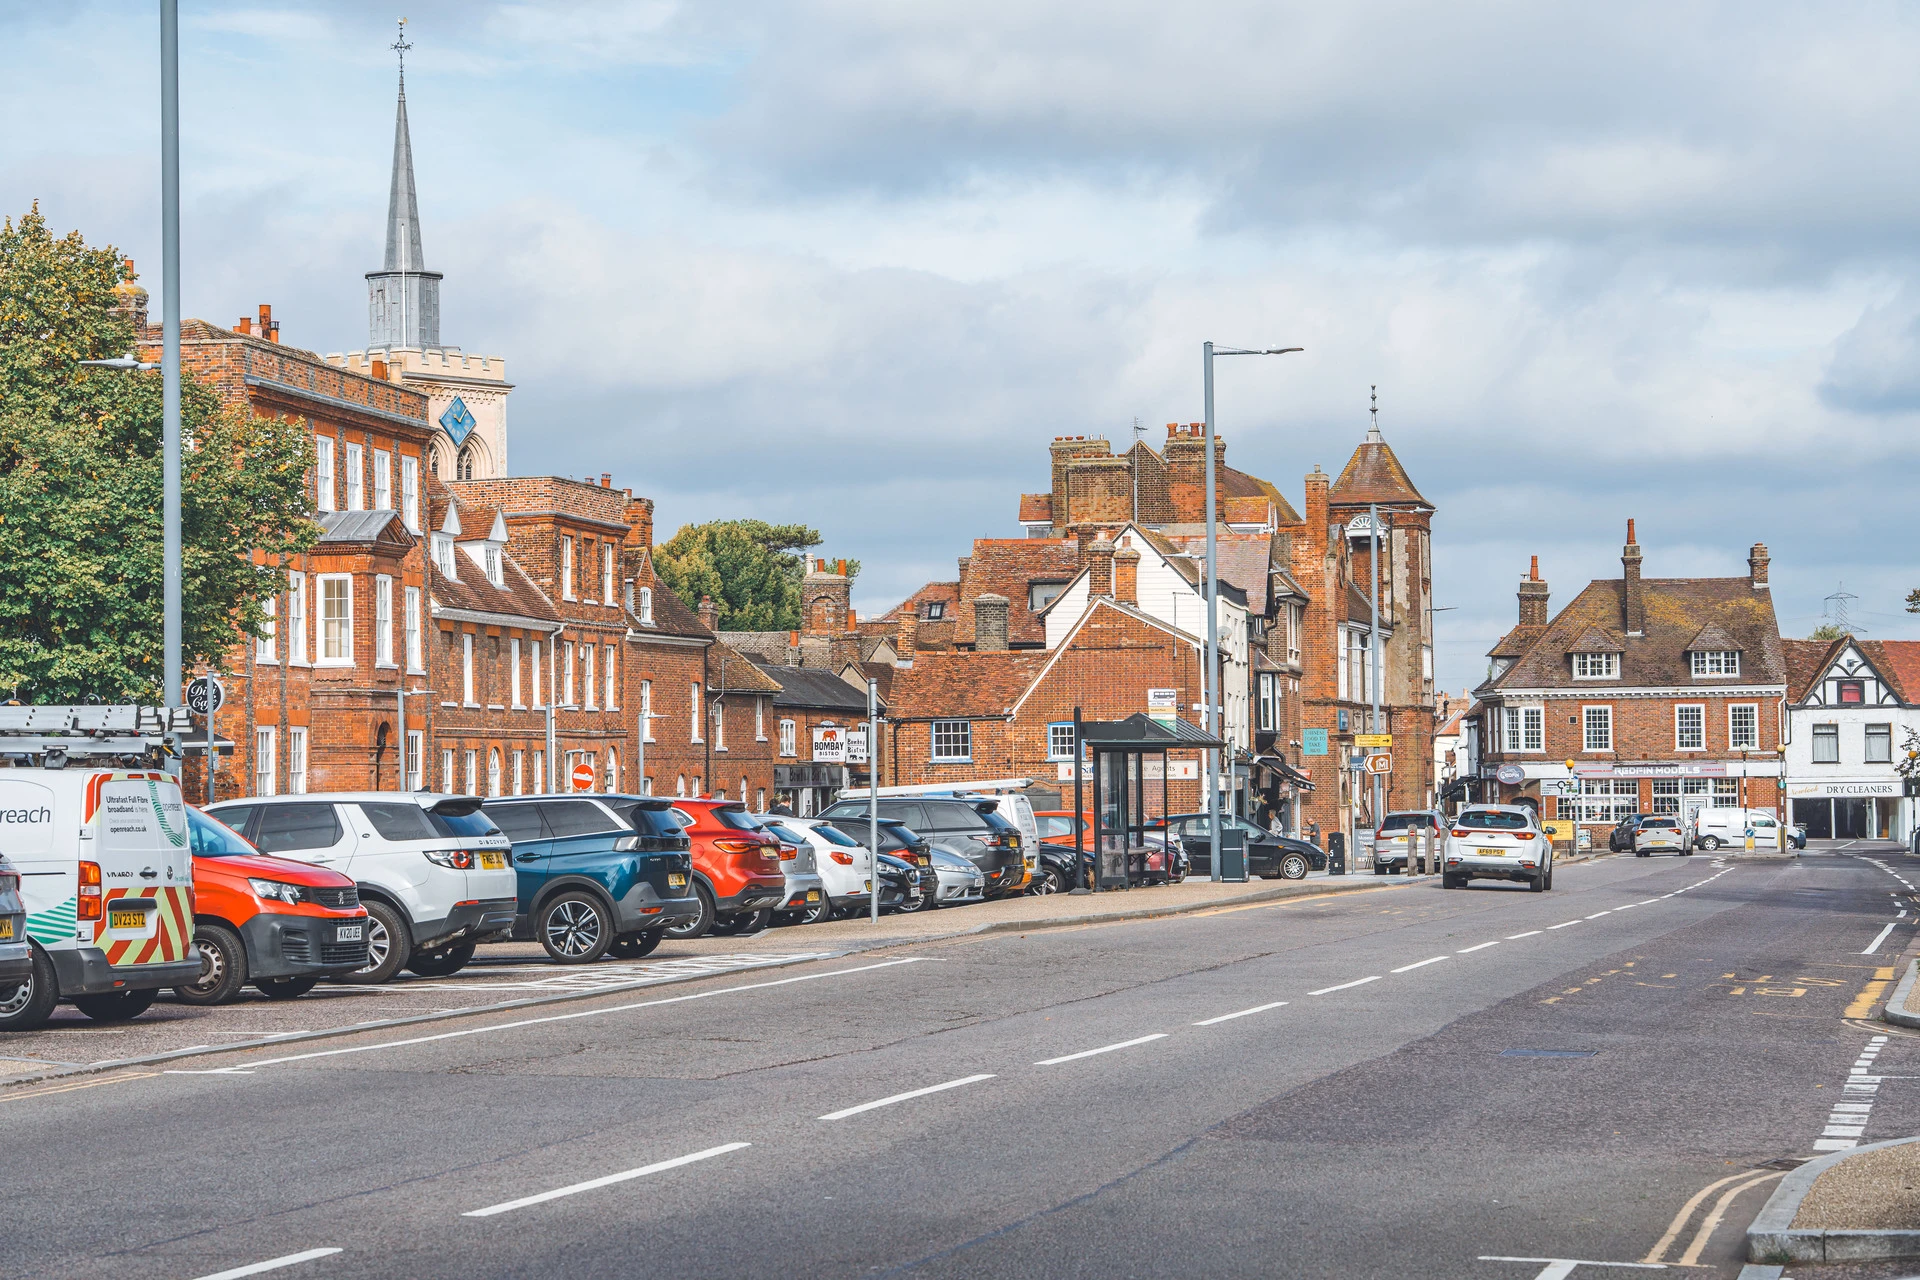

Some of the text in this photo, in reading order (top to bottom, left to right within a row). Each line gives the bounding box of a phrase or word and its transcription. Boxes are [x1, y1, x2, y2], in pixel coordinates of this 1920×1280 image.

[190, 684, 218, 696] Dii
[814, 742, 844, 750] BOMBAY
[1614, 766, 1652, 776] REDFIN
[114, 913, 145, 925] DV23 STZ
